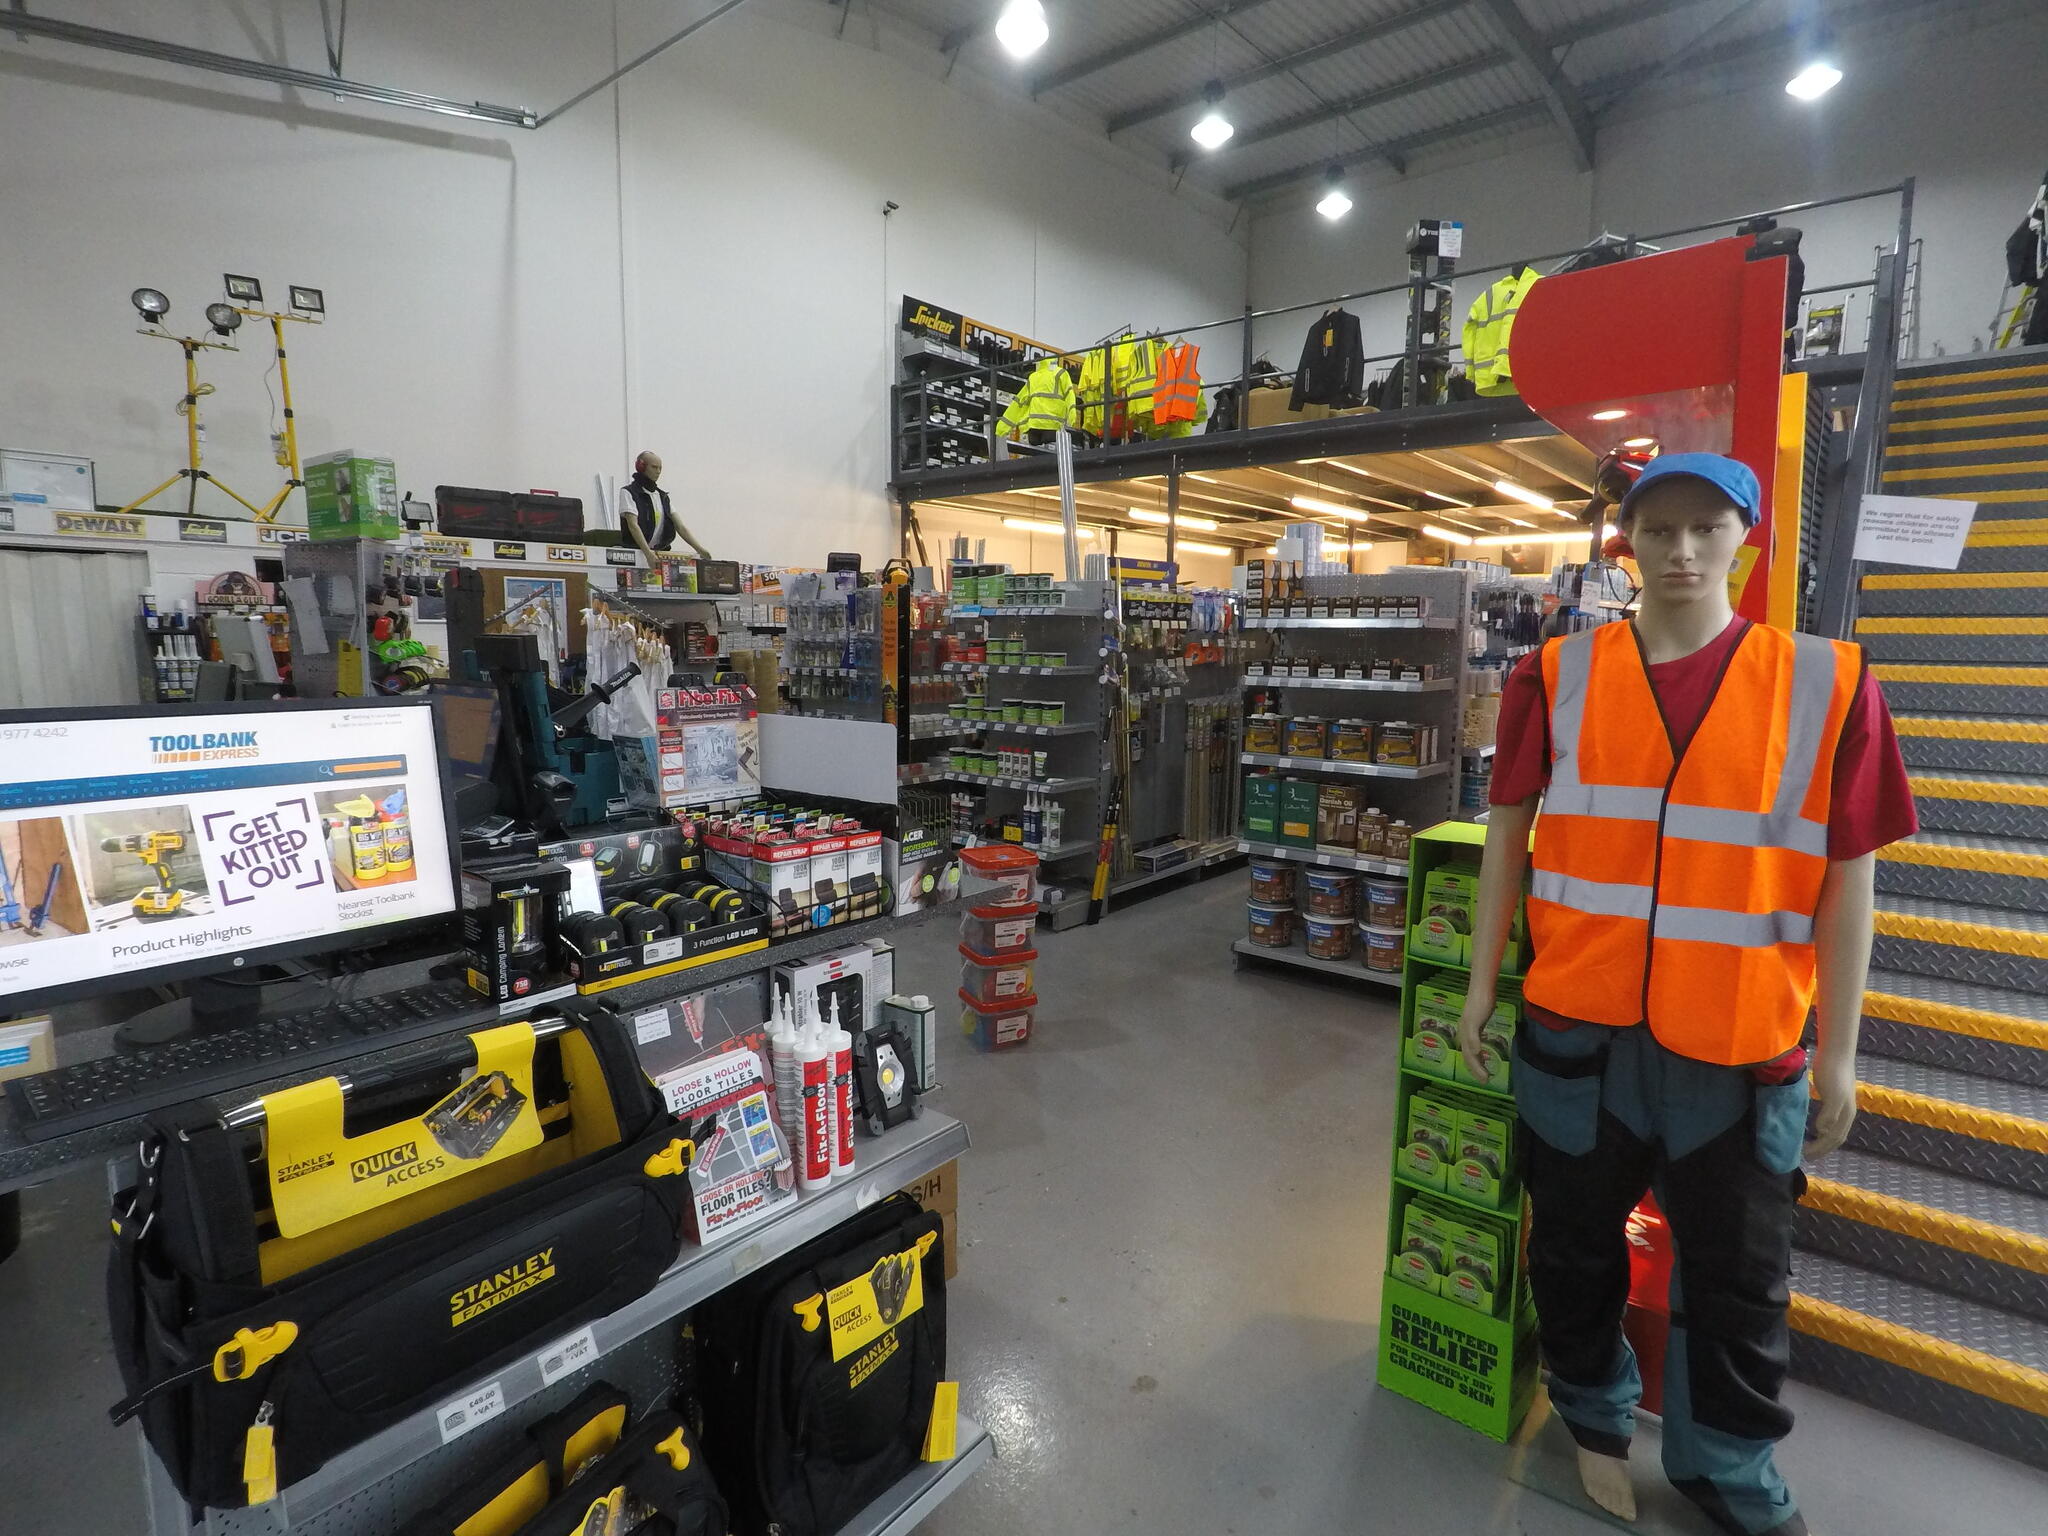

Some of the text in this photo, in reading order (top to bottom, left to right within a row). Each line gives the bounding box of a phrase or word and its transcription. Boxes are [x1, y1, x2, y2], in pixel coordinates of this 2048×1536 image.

[550, 548, 585, 561] JCB
[33, 727, 69, 738] 4242
[150, 731, 259, 752] TOOLBANK
[203, 747, 260, 761] EXPRESS
[229, 811, 281, 845] GET
[220, 829, 308, 875] KITTED
[248, 853, 303, 889] OUT
[337, 890, 416, 911] Nearest Toolbank
[112, 937, 176, 958] Product
[179, 923, 253, 947] Highlights
[726, 932, 739, 941] LED
[740, 927, 758, 939] Lamp
[671, 1059, 752, 1097] LOOSE & HOLLOW
[674, 1069, 754, 1108] FLOOR TILES
[277, 1152, 334, 1177] STANLEY
[352, 1143, 417, 1180] QUICK
[386, 1156, 445, 1188] ACCESS
[700, 1188, 723, 1204] LOOSE
[723, 1183, 734, 1195] OR
[701, 1193, 736, 1216] FLOOR
[450, 1248, 553, 1313] STANLEY
[463, 1272, 544, 1320] FATMAX
[833, 1306, 861, 1331] QUICK
[846, 1312, 872, 1334] ACCESS
[1391, 1303, 1498, 1357] GUARANTEED
[850, 1328, 898, 1379] STANLEY
[1390, 1316, 1498, 1378] RELIEF
[1390, 1342, 1408, 1356] FOR
[1411, 1350, 1470, 1383] EXTREMELY
[1389, 1351, 1495, 1409] CRACKED SKIN
